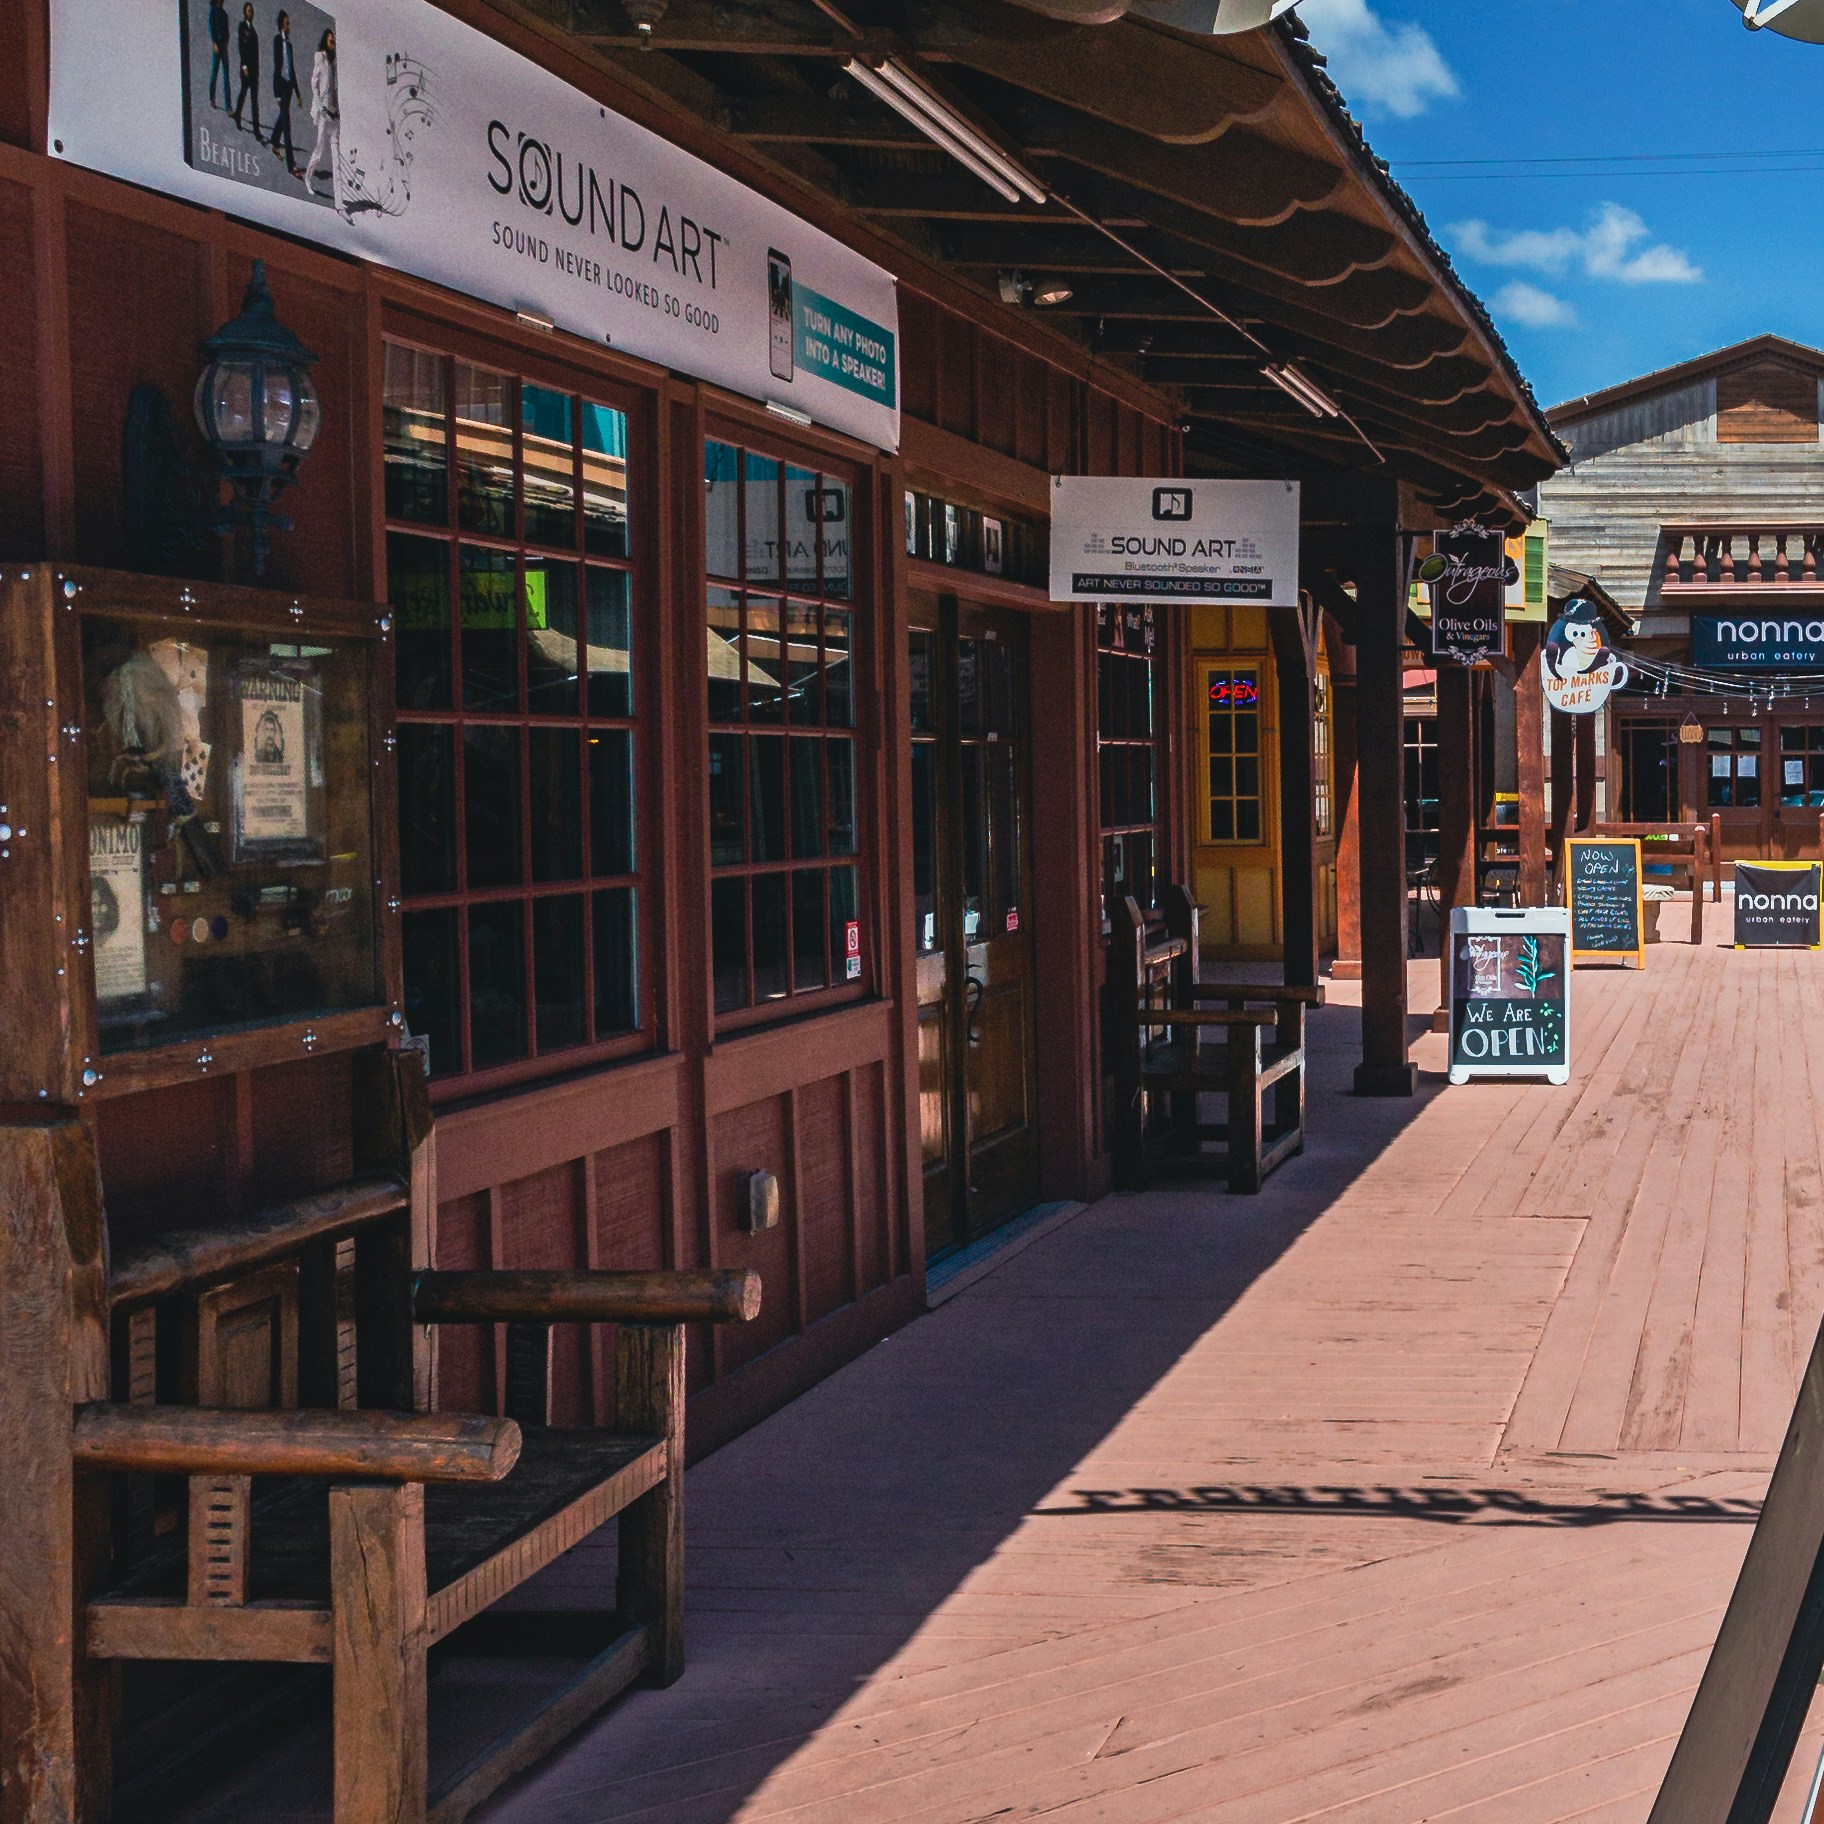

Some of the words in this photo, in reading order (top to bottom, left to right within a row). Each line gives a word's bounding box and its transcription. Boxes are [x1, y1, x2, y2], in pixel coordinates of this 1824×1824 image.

[487, 119, 646, 252] SOUND
[492, 220, 548, 264] SOUND
[555, 246, 601, 286] NEVER
[607, 269, 659, 309] LOOKED
[664, 293, 680, 318] SO
[685, 302, 720, 334] GOOD
[803, 306, 832, 338] TURN
[833, 322, 854, 348] ANY
[855, 332, 887, 365] PHOTO
[805, 335, 830, 365] INTO
[832, 349, 840, 370] A
[841, 353, 887, 391] SPEAKER!
[1111, 536, 1187, 556] SOUND
[1191, 539, 1237, 559] ART
[1179, 563, 1221, 575] Speaker
[1077, 578, 1101, 589] ART
[1103, 579, 1142, 590] NEVER
[1144, 580, 1201, 591] SOUNDED
[1204, 582, 1221, 593] SO
[1439, 618, 1471, 631] Olive
[1473, 618, 1498, 632] Oils
[1446, 632, 1455, 641] &
[1456, 632, 1490, 643] Vinegars
[1727, 651, 1765, 661] urban
[1774, 651, 1816, 662] eatery
[1546, 677, 1567, 692] TOP
[1571, 671, 1610, 690] MARKS
[1209, 684, 1259, 701] OPEN
[1560, 686, 1592, 707] CAFÉ
[1580, 849, 1614, 863] NOW
[1585, 859, 1619, 875] OPEN
[1738, 894, 1818, 911] nonna
[1779, 916, 1810, 924] eatery
[1461, 1027, 1545, 1058] OPEN
